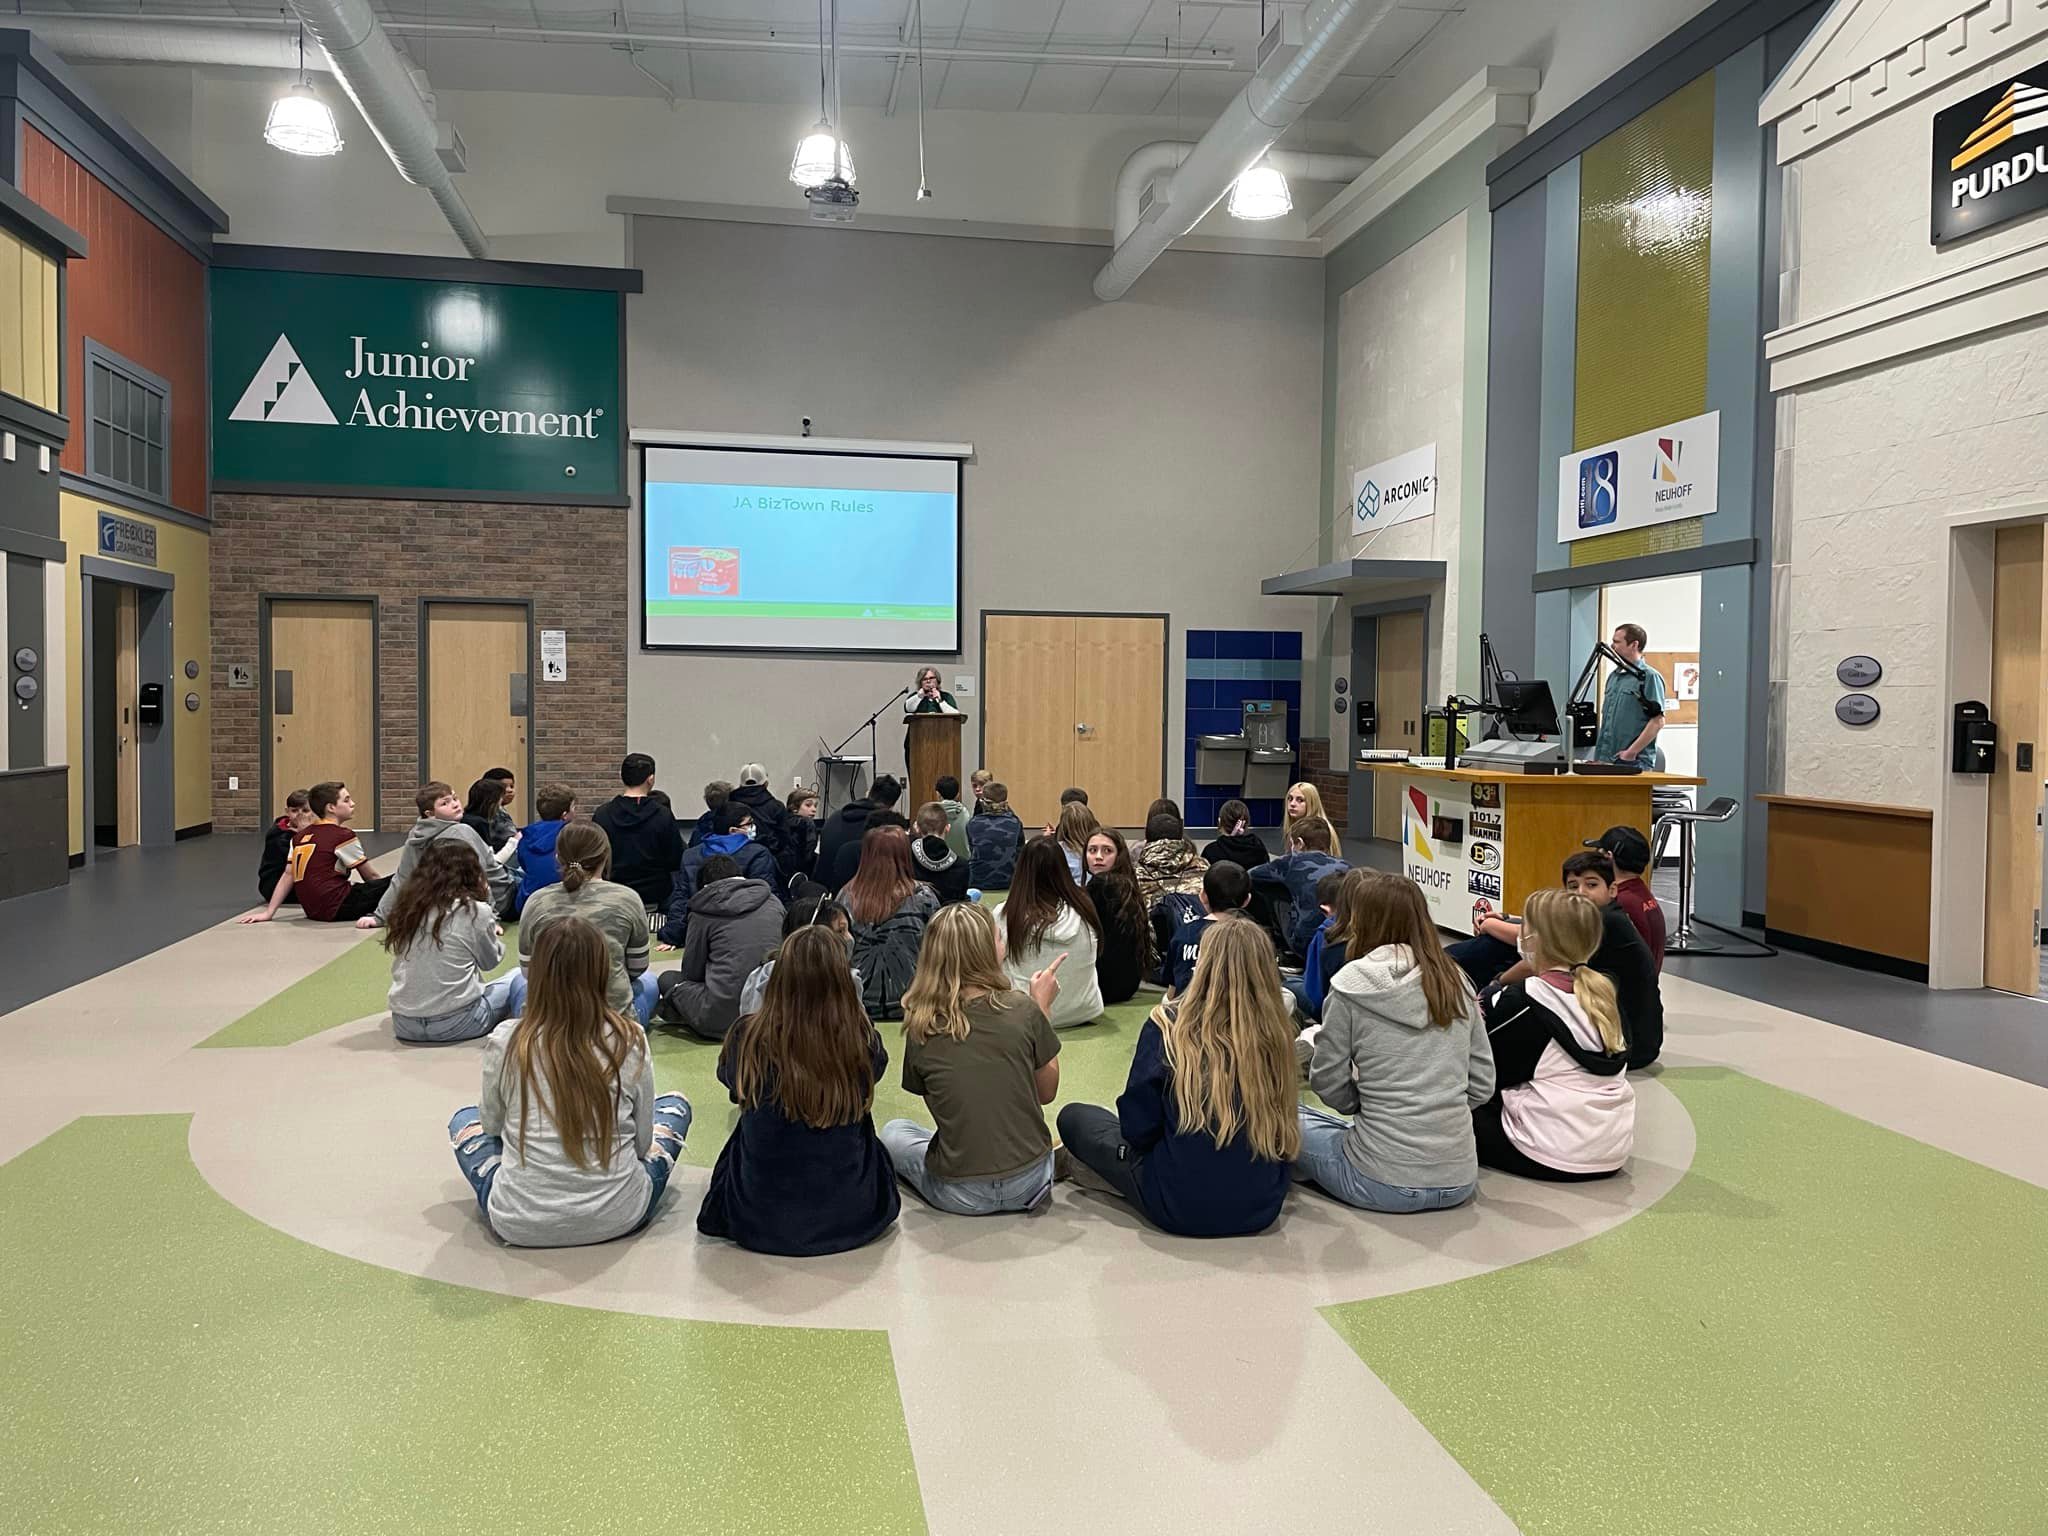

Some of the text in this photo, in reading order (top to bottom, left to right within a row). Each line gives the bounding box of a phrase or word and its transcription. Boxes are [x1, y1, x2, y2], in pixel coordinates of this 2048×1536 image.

[345, 336, 475, 382] Junior
[1383, 476, 1429, 506] ARCONIC
[1655, 483, 1694, 503] NEUHOFF
[733, 496, 874, 513] JA BizTown Rules
[1473, 811, 1501, 825] 101.7
[1472, 827, 1502, 842] HAMMER
[1473, 845, 1485, 863] B
[1407, 863, 1452, 891] NEUHOFF
[1469, 870, 1500, 893] K105
